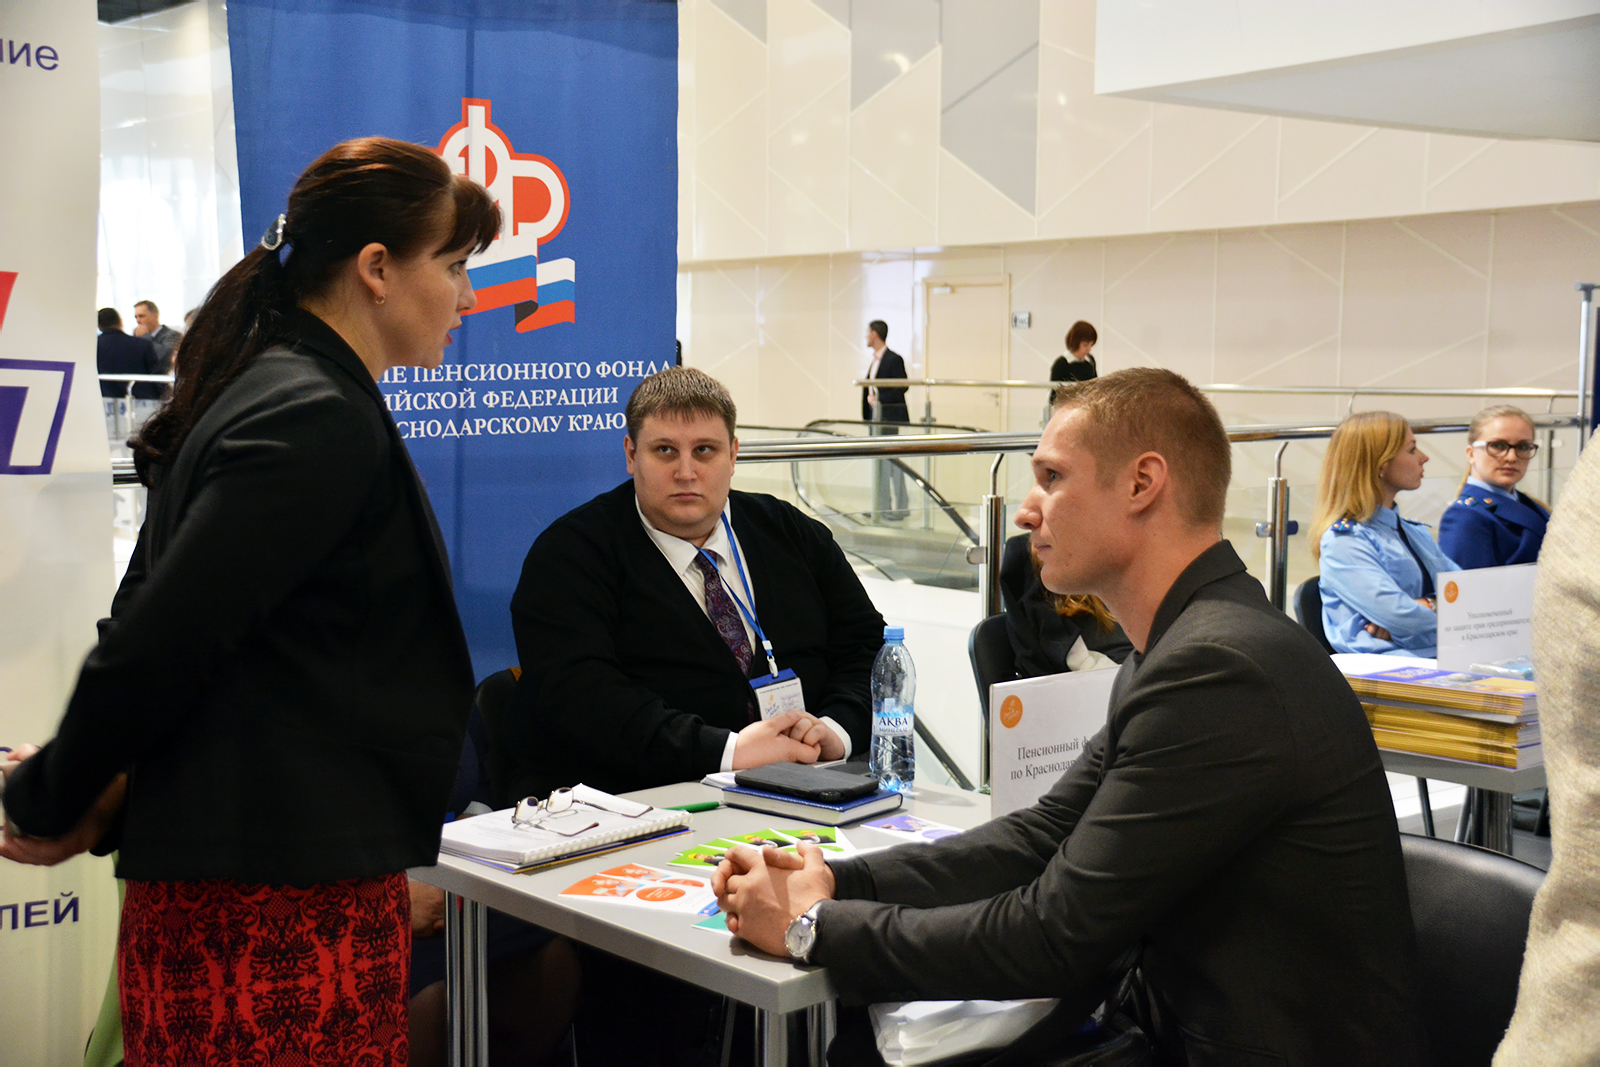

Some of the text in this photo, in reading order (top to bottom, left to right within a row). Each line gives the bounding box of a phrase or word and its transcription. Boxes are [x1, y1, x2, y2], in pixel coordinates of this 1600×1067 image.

[0, 38, 59, 71] ие
[413, 362, 591, 383] ПЕНСИОННОГО
[482, 387, 618, 410] ФЕДЕРАЦИИ
[396, 412, 627, 439] СНОДАРСКОМУ КРАЮ
[879, 716, 908, 728] АКВА
[1018, 738, 1079, 760] Пенсионный
[1010, 770, 1022, 780] по
